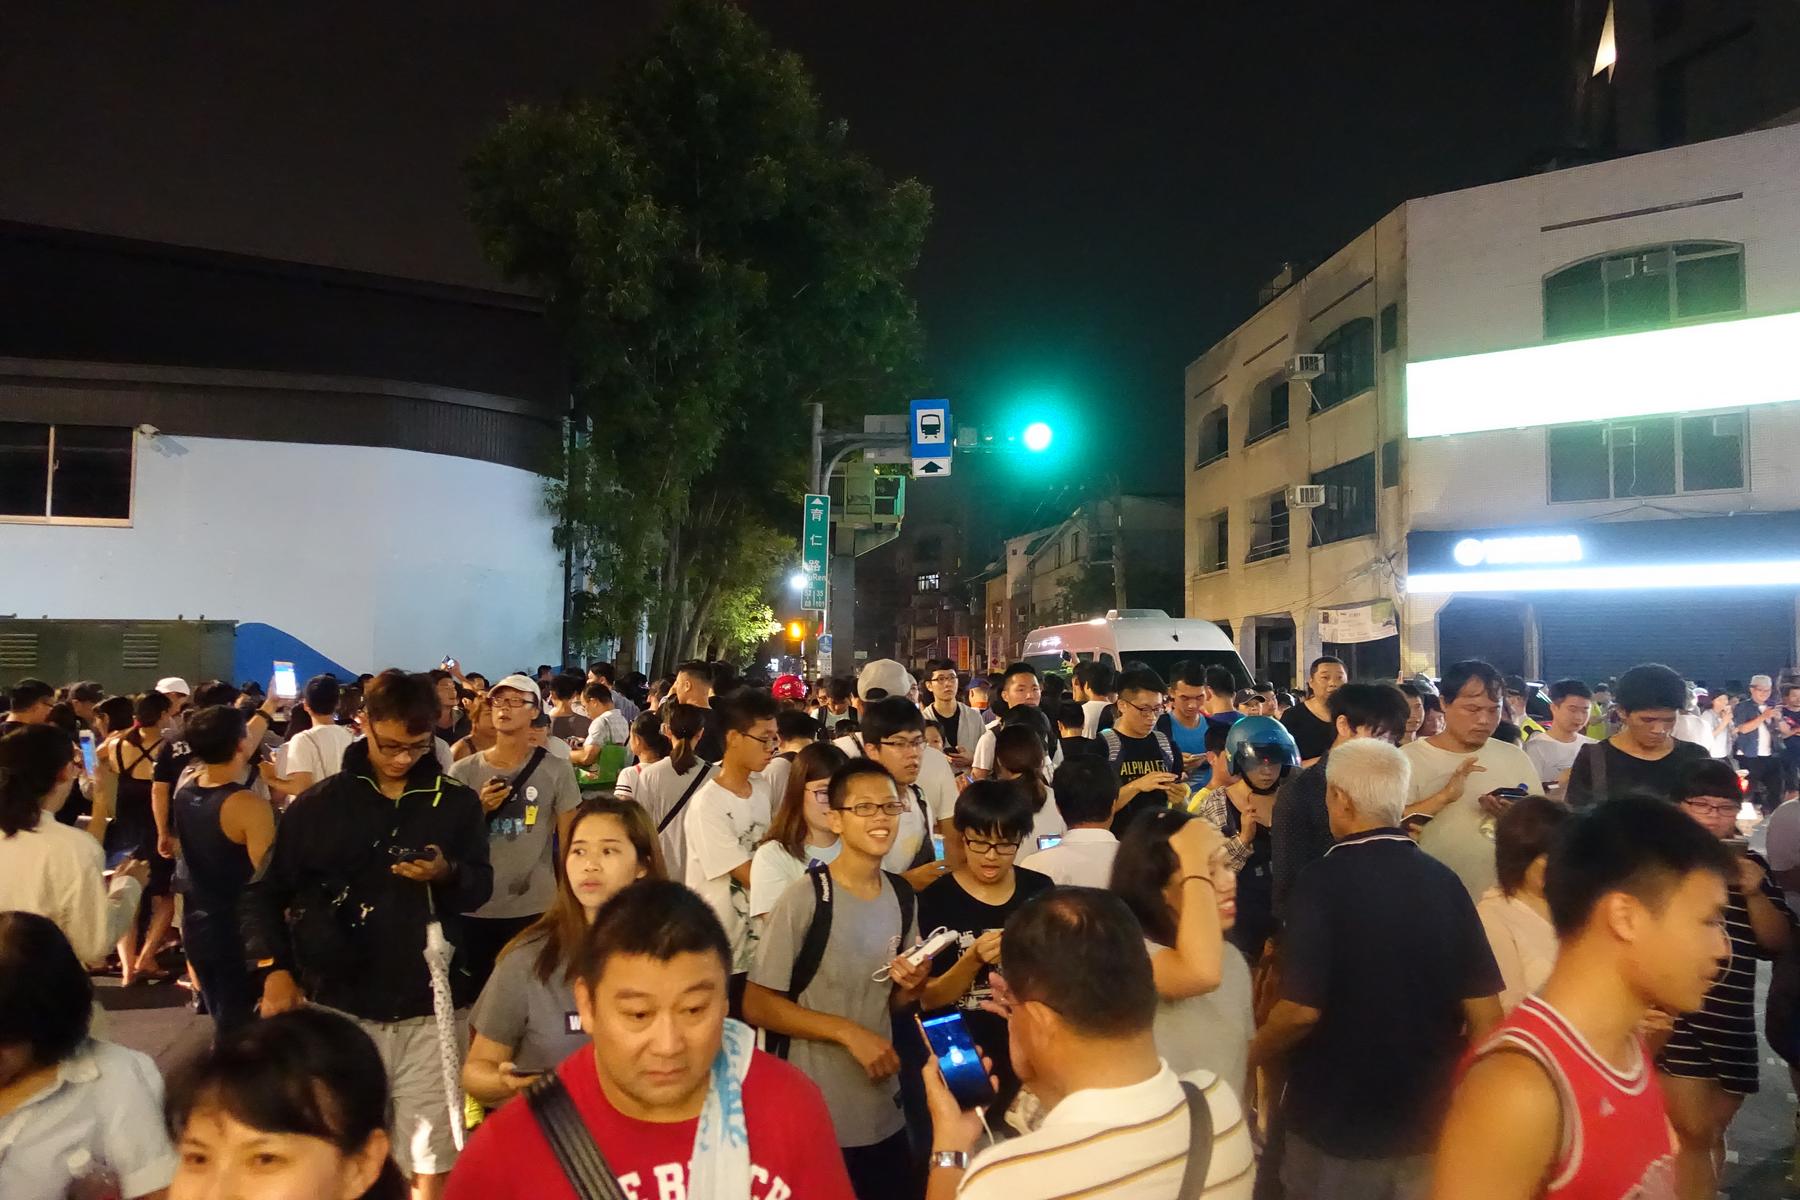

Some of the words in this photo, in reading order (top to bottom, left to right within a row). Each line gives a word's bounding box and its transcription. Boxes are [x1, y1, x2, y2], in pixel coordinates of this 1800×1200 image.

[809, 507, 824, 572] 育仁路
[818, 872, 830, 902] Reebok
